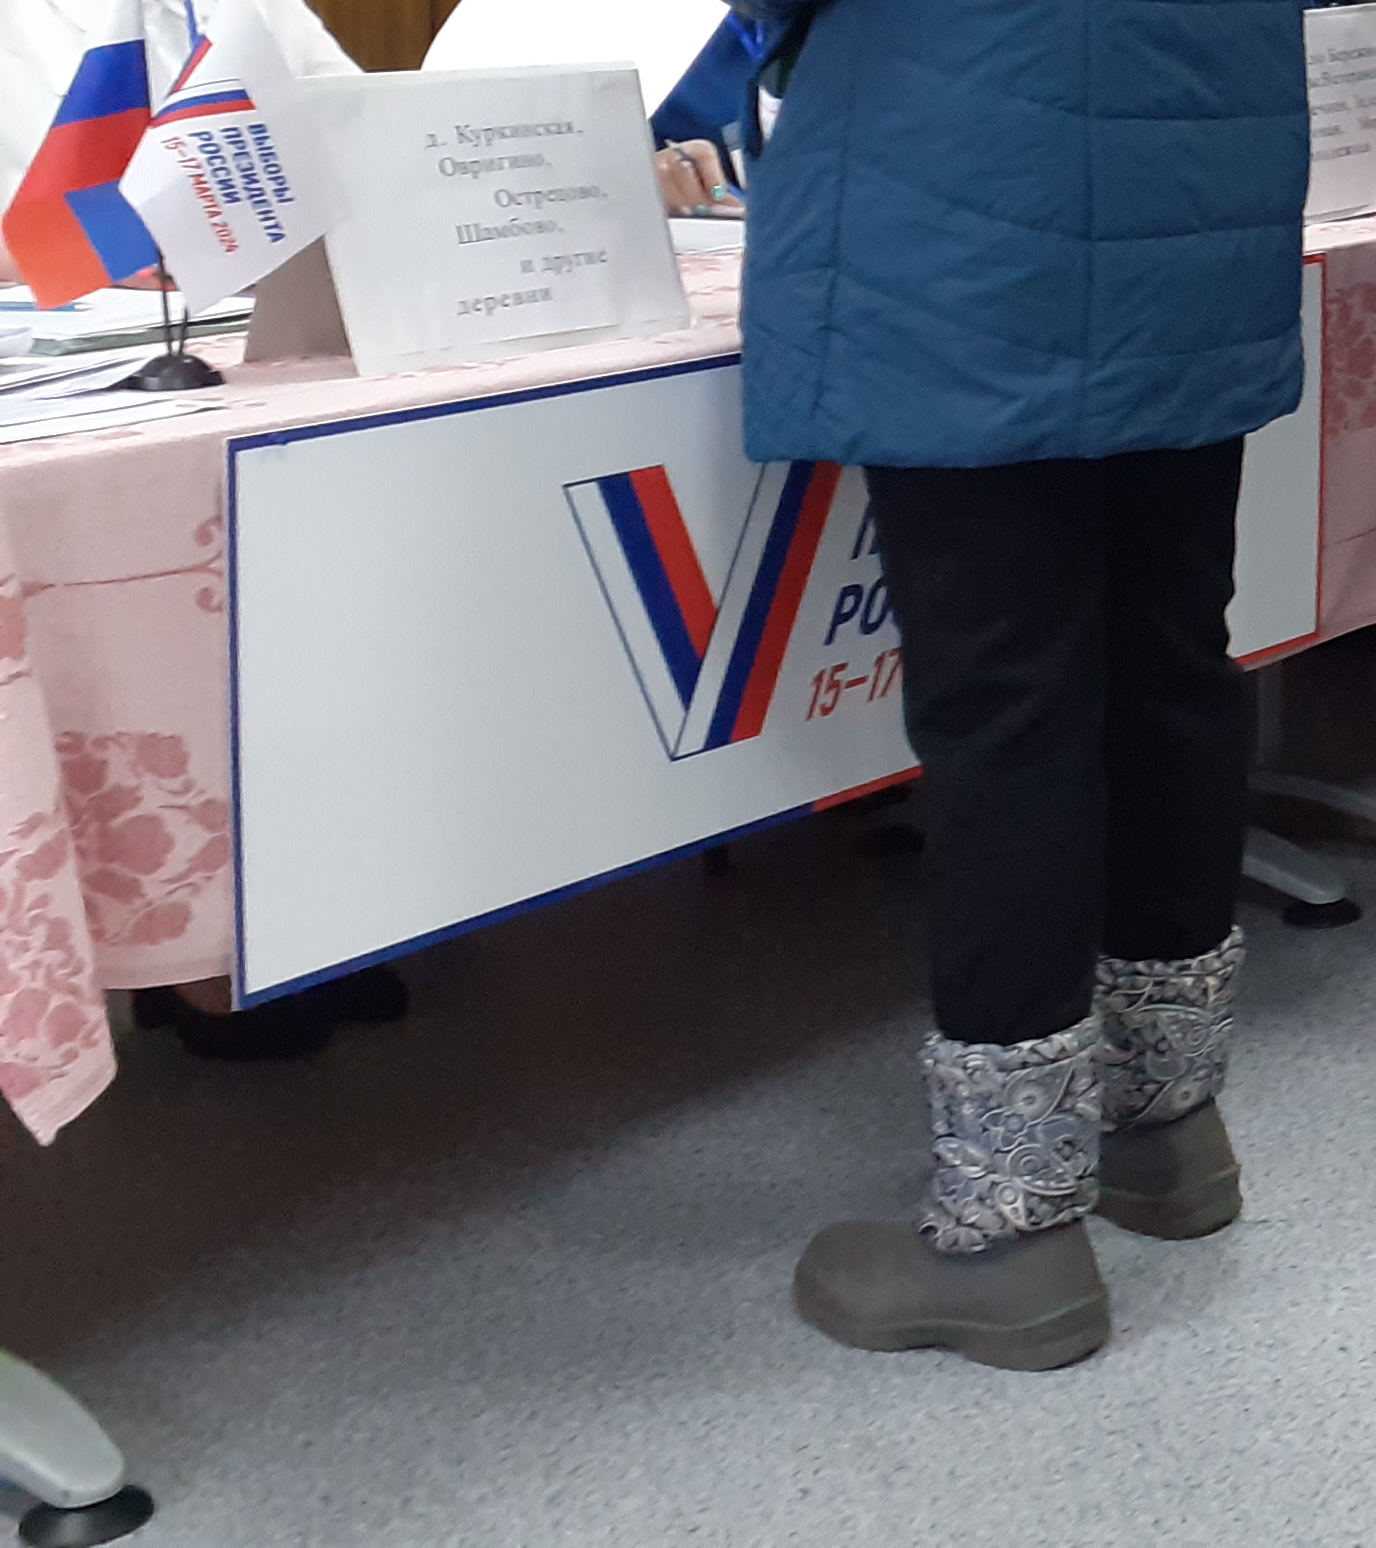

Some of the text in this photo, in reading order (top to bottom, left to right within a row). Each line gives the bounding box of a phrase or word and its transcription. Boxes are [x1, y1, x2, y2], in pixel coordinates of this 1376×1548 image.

[186, 130, 242, 205] РОССИИ
[219, 126, 286, 244] ПРЕЗИДЕНТА
[247, 123, 294, 204] ВЫБОРЫ
[187, 173, 223, 219] МАРТА
[211, 221, 239, 254] 2024
[520, 250, 608, 275] и другие
[456, 287, 553, 317] деревни
